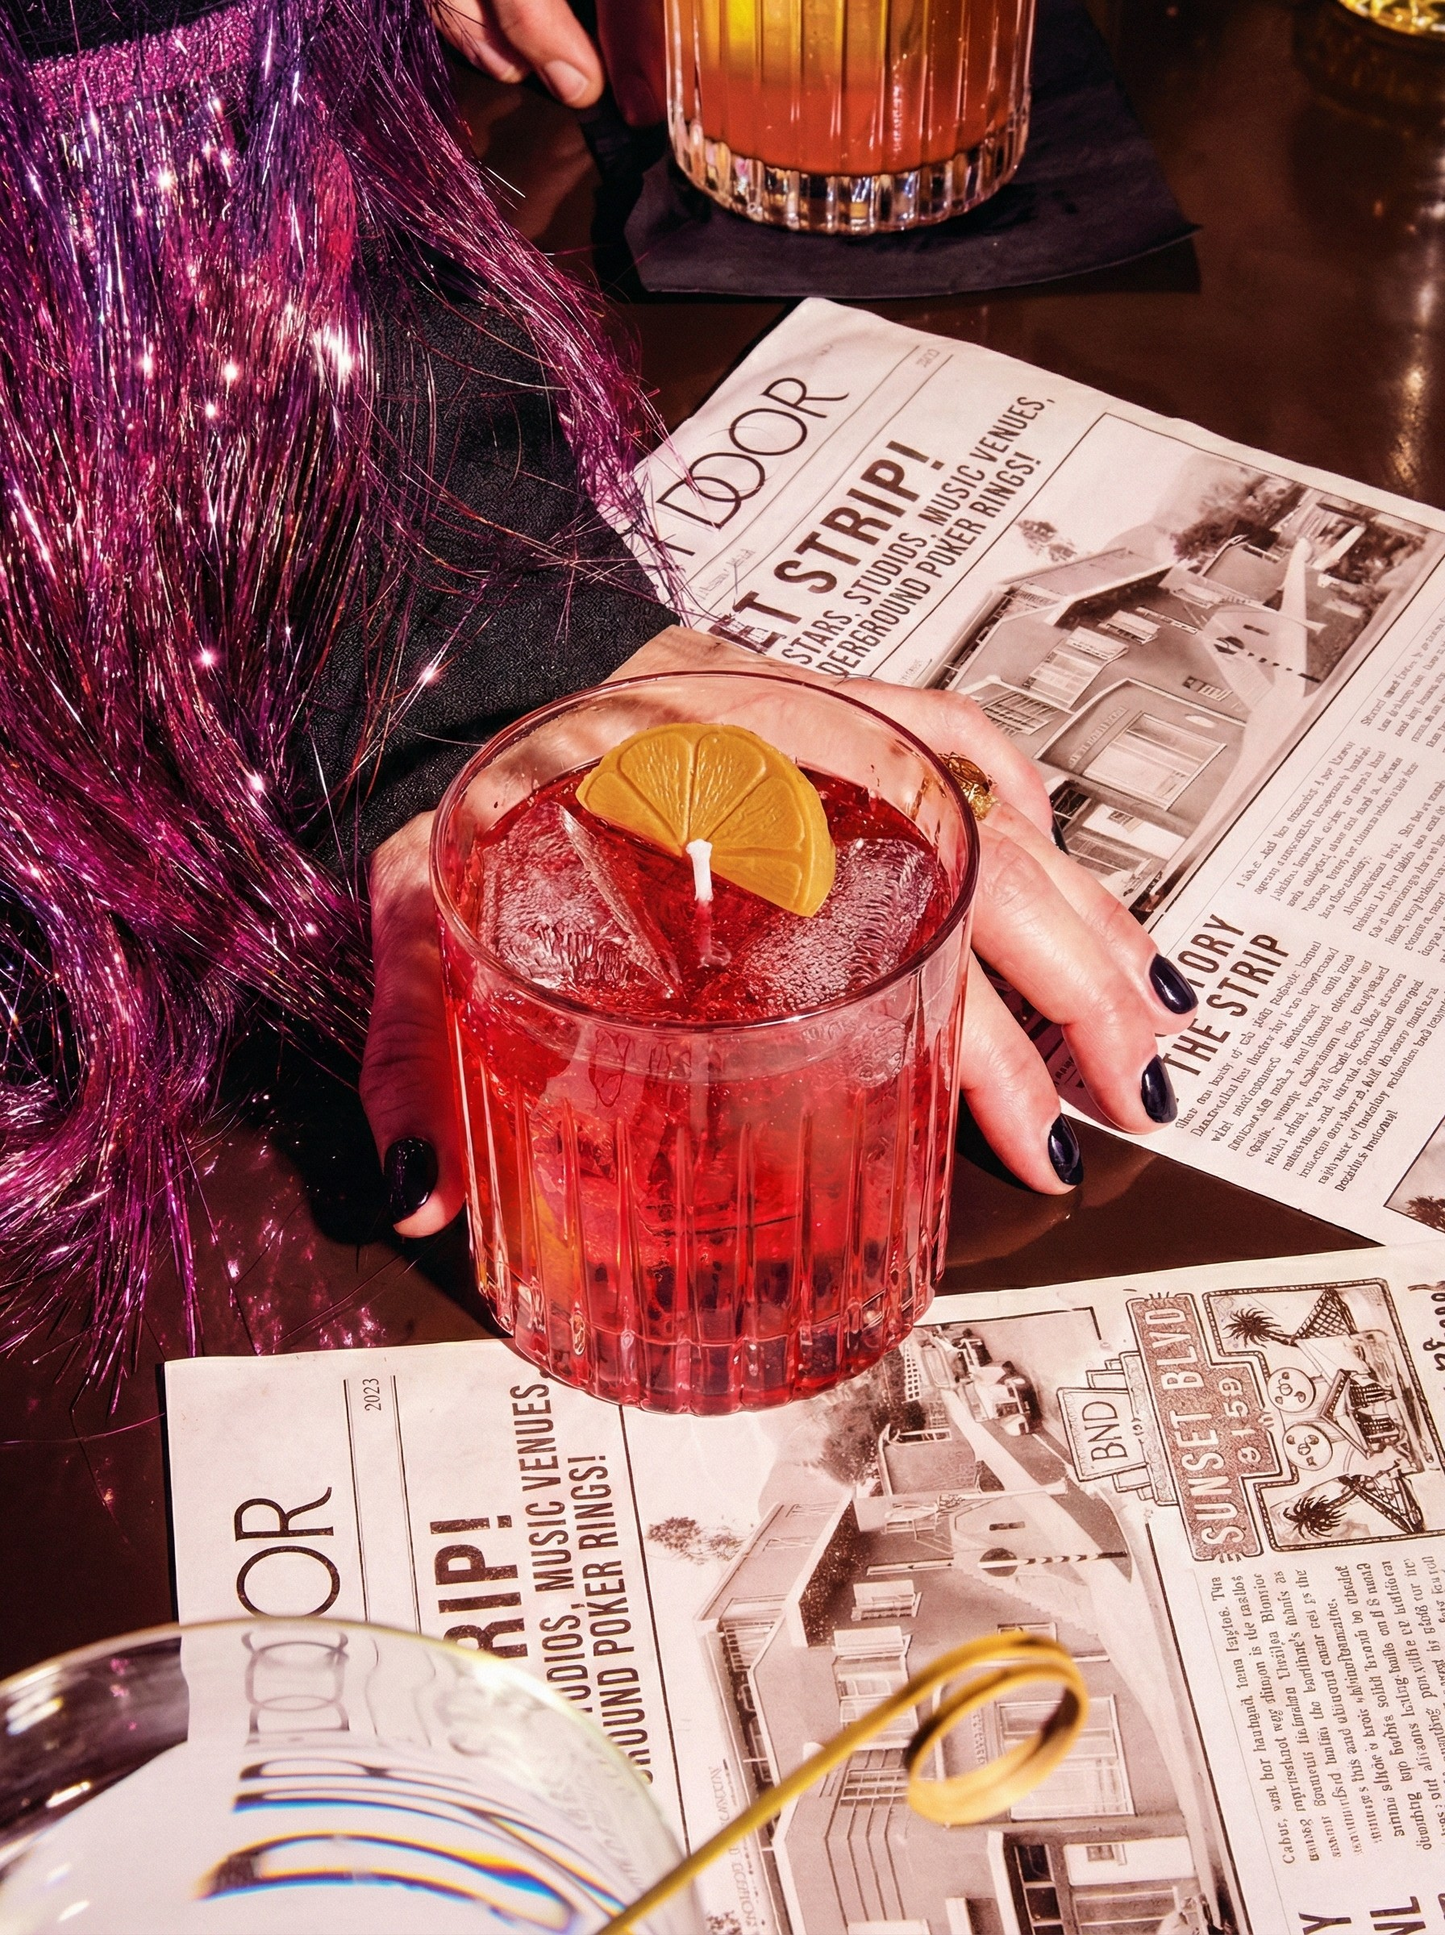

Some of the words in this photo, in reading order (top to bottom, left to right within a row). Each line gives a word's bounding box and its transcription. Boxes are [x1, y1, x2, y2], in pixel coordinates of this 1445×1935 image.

[656, 377, 848, 529] DOOR
[774, 441, 944, 593] STRIP!
[782, 611, 861, 664] STARS,
[844, 533, 936, 605] STUDIOS,
[918, 454, 985, 526] MUSIC
[970, 397, 1054, 462] VENUES,
[915, 519, 986, 577] POKER
[970, 452, 1040, 518] RINGS!
[1159, 1019, 1230, 1075] THE
[1206, 935, 1288, 1016] STRIP
[363, 1379, 381, 1410] 2023
[1143, 1305, 1204, 1390] BLVD
[1083, 1400, 1129, 1461] BND
[1170, 1411, 1246, 1547] SUNSET
[526, 1501, 574, 1592] MUSIC
[568, 1456, 618, 1550] RINGS!
[583, 1561, 634, 1656] POKER
